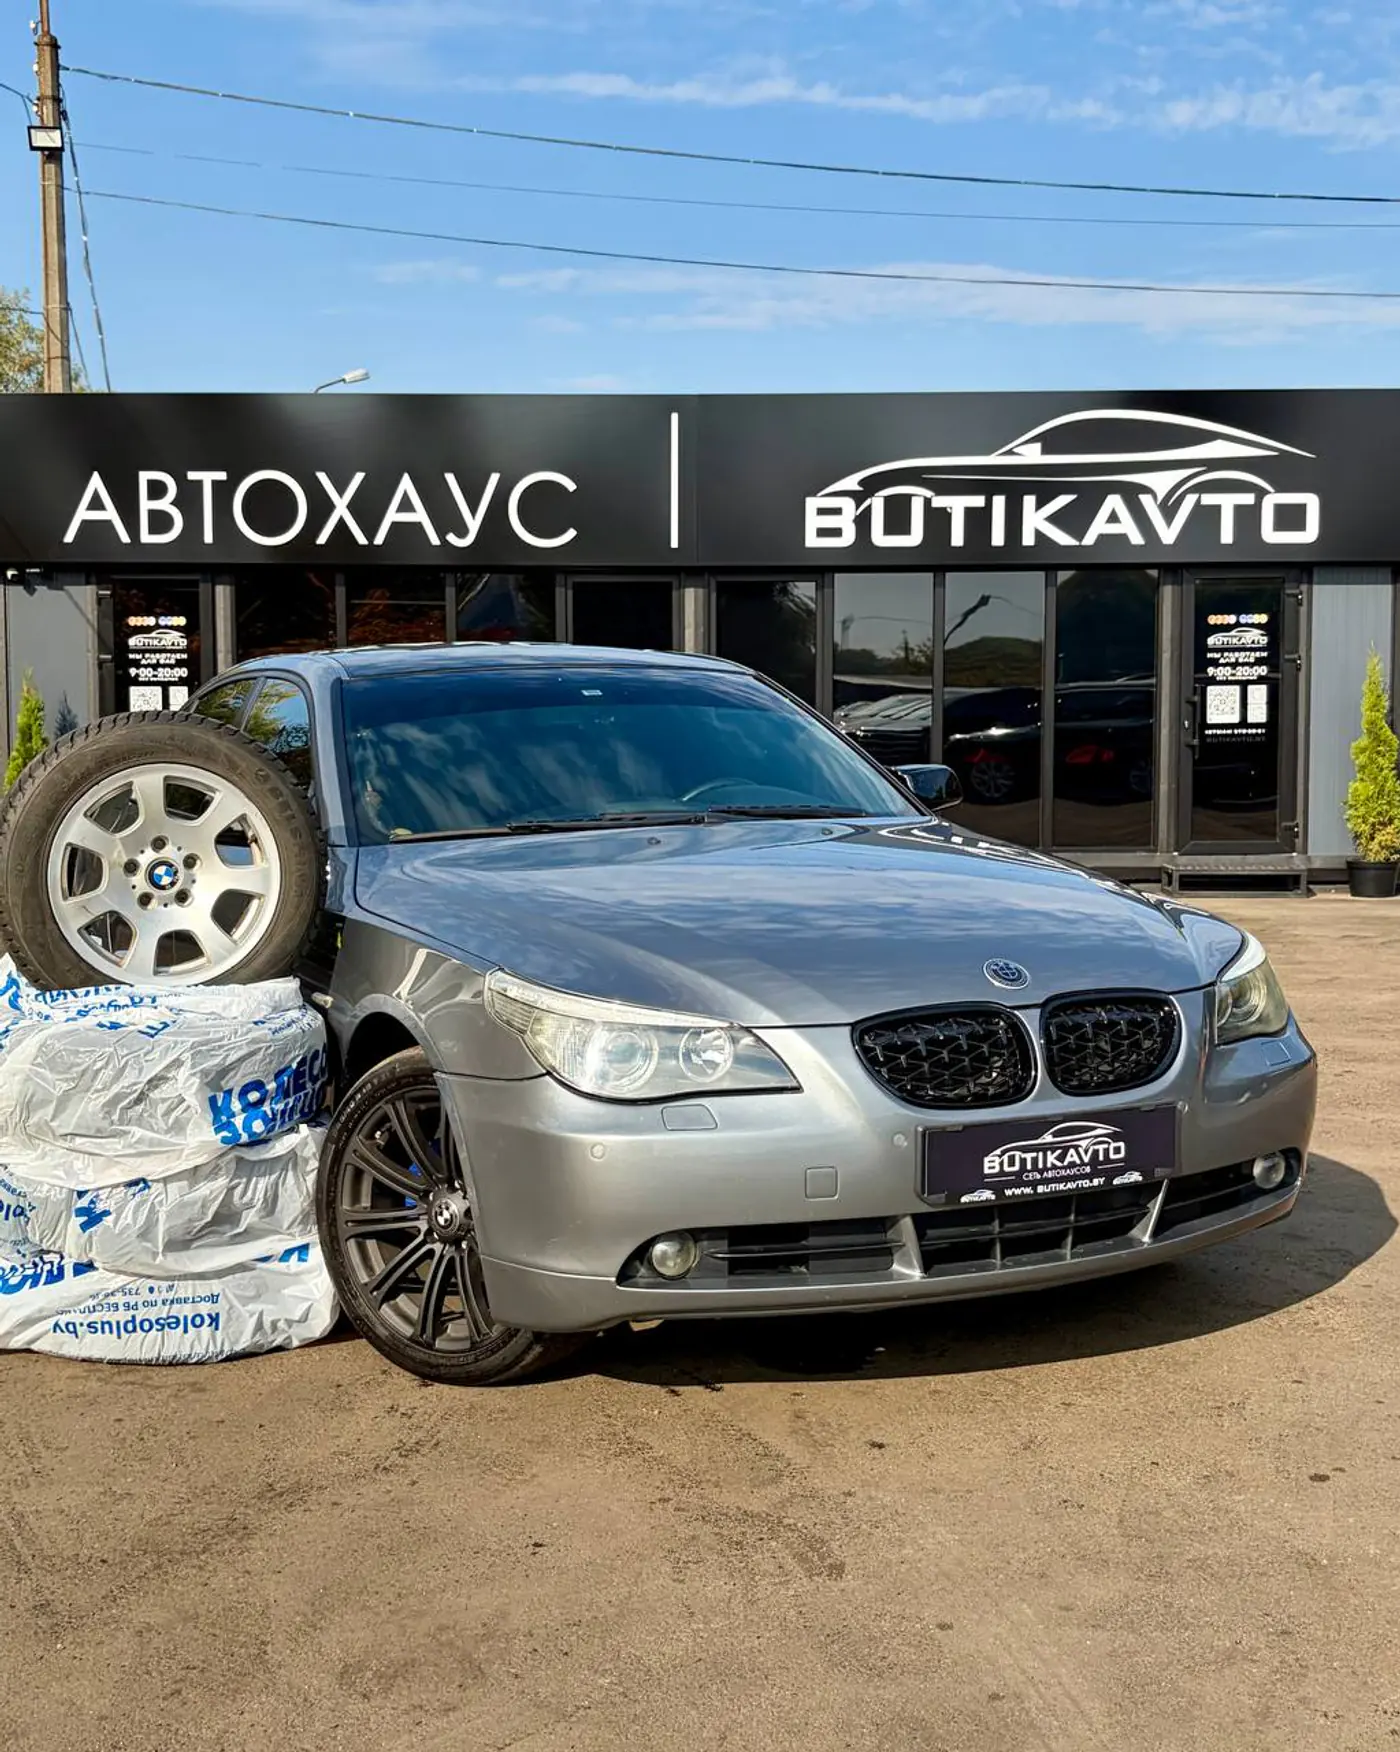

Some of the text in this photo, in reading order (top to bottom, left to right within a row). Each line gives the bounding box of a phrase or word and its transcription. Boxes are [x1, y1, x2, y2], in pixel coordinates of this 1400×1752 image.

[63, 469, 578, 548] АВТОХАУС
[804, 491, 1320, 548] BUTIKAVTO
[1206, 665, 1268, 677] 9:00-20:00
[983, 1141, 1126, 1174] BUTIKAVTO
[1022, 1165, 1091, 1181] СЕТЬ АВТОХАУСОВ
[123, 1301, 139, 1312] РБ
[142, 1298, 158, 1308] по
[162, 1292, 220, 1305] Доставка
[52, 1311, 221, 1340] kolesoplus.by
